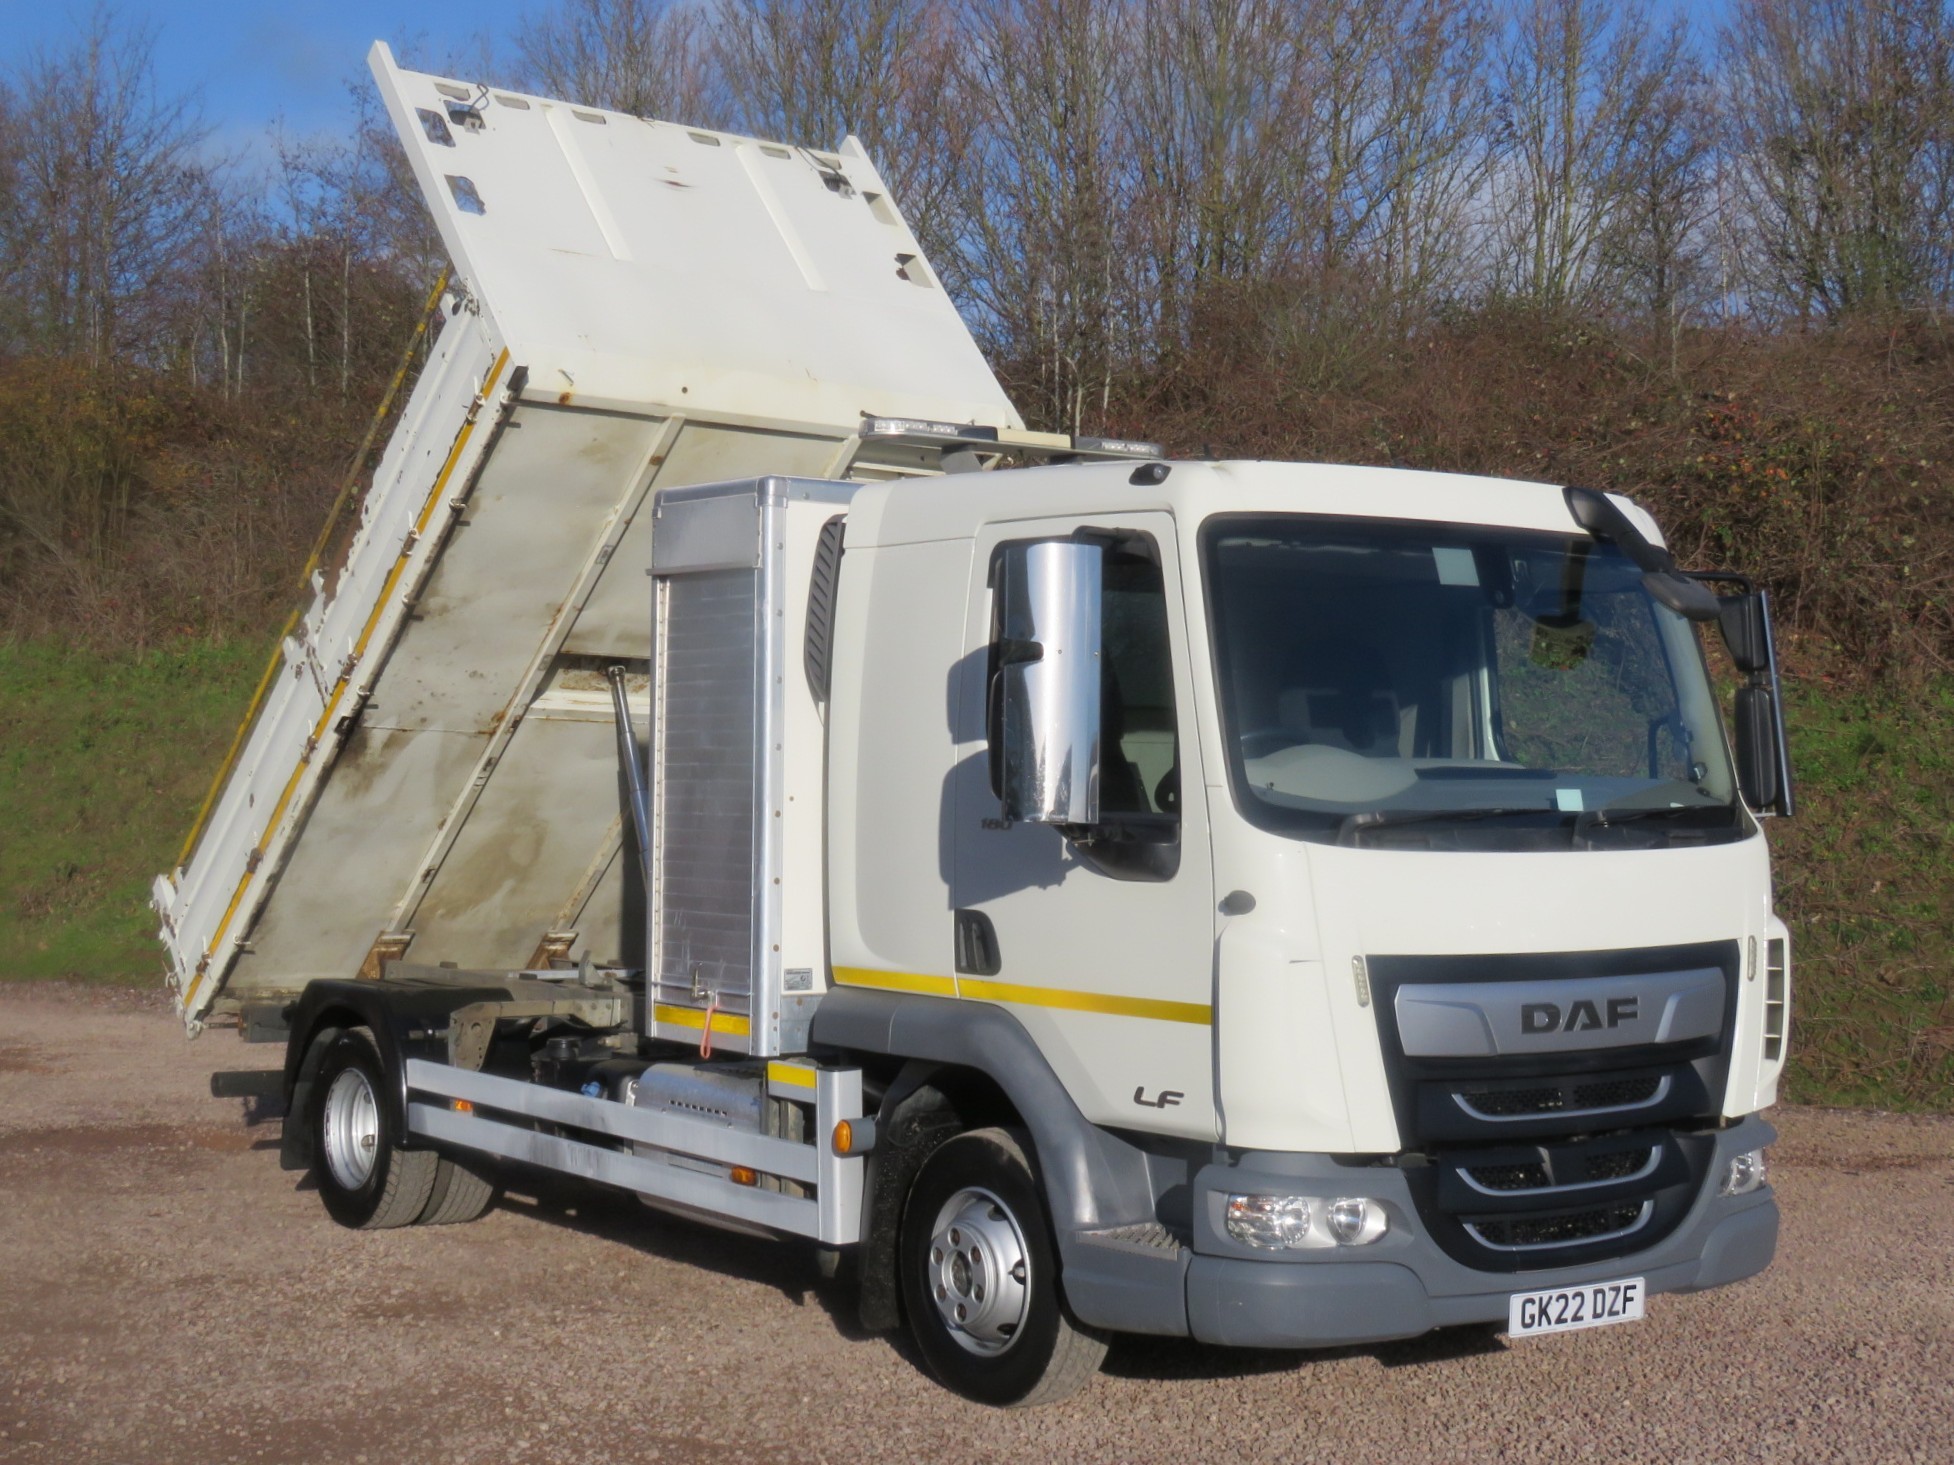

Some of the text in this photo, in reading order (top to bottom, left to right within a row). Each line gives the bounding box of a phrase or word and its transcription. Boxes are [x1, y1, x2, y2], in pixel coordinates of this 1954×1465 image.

[1521, 997, 1639, 1034] DAF
[1134, 1086, 1184, 1109] LF
[1520, 1284, 1637, 1329] GK22 DZF
